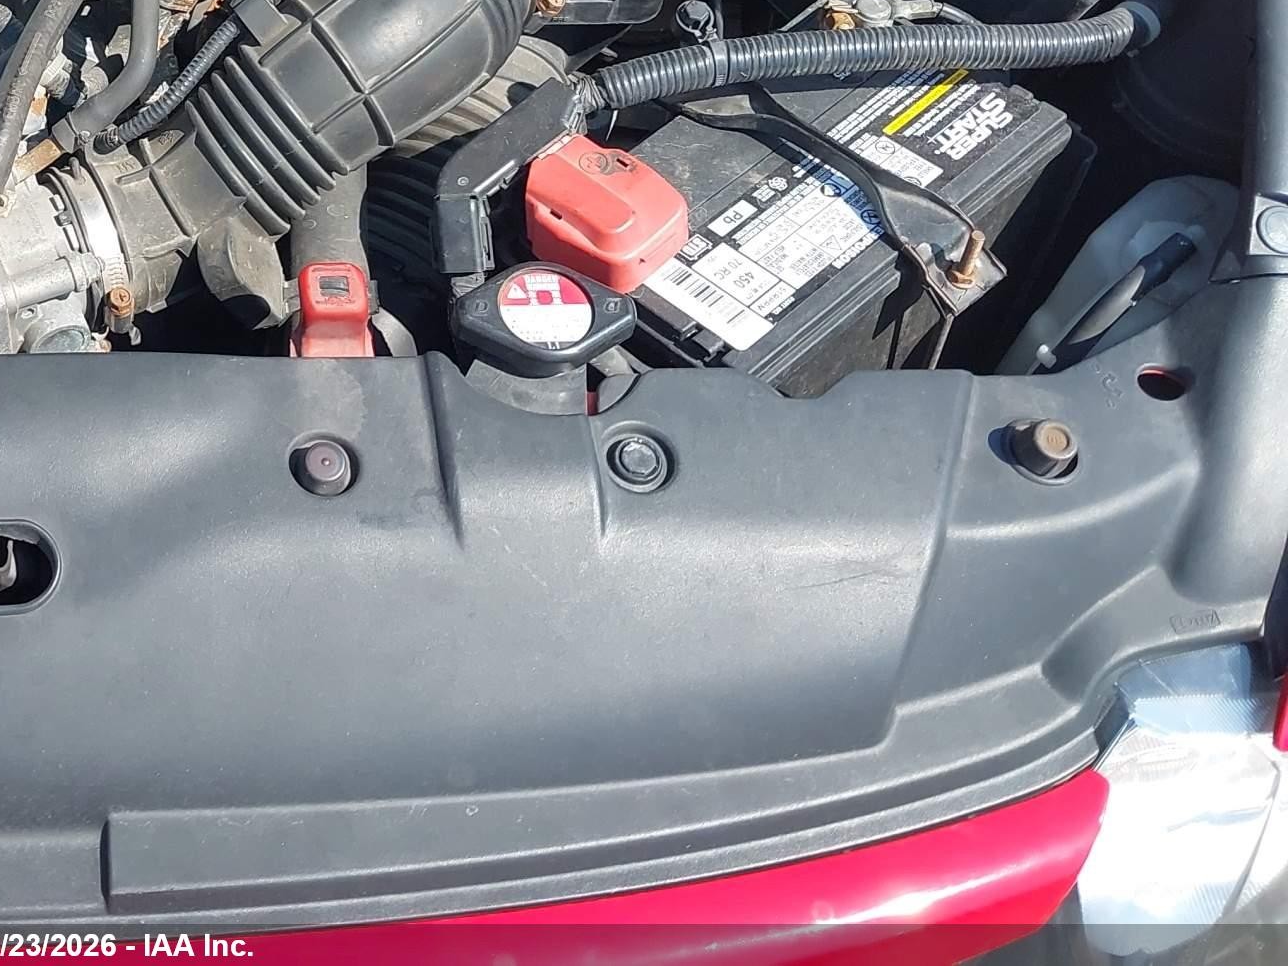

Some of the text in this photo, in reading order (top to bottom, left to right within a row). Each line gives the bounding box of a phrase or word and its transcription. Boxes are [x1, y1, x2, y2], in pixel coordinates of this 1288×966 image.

[938, 92, 1008, 152] START
[947, 111, 1013, 161] SUPER
[722, 209, 742, 228] Pb
[713, 265, 730, 282] RC
[727, 256, 743, 271] 70
[732, 269, 756, 291] 450
